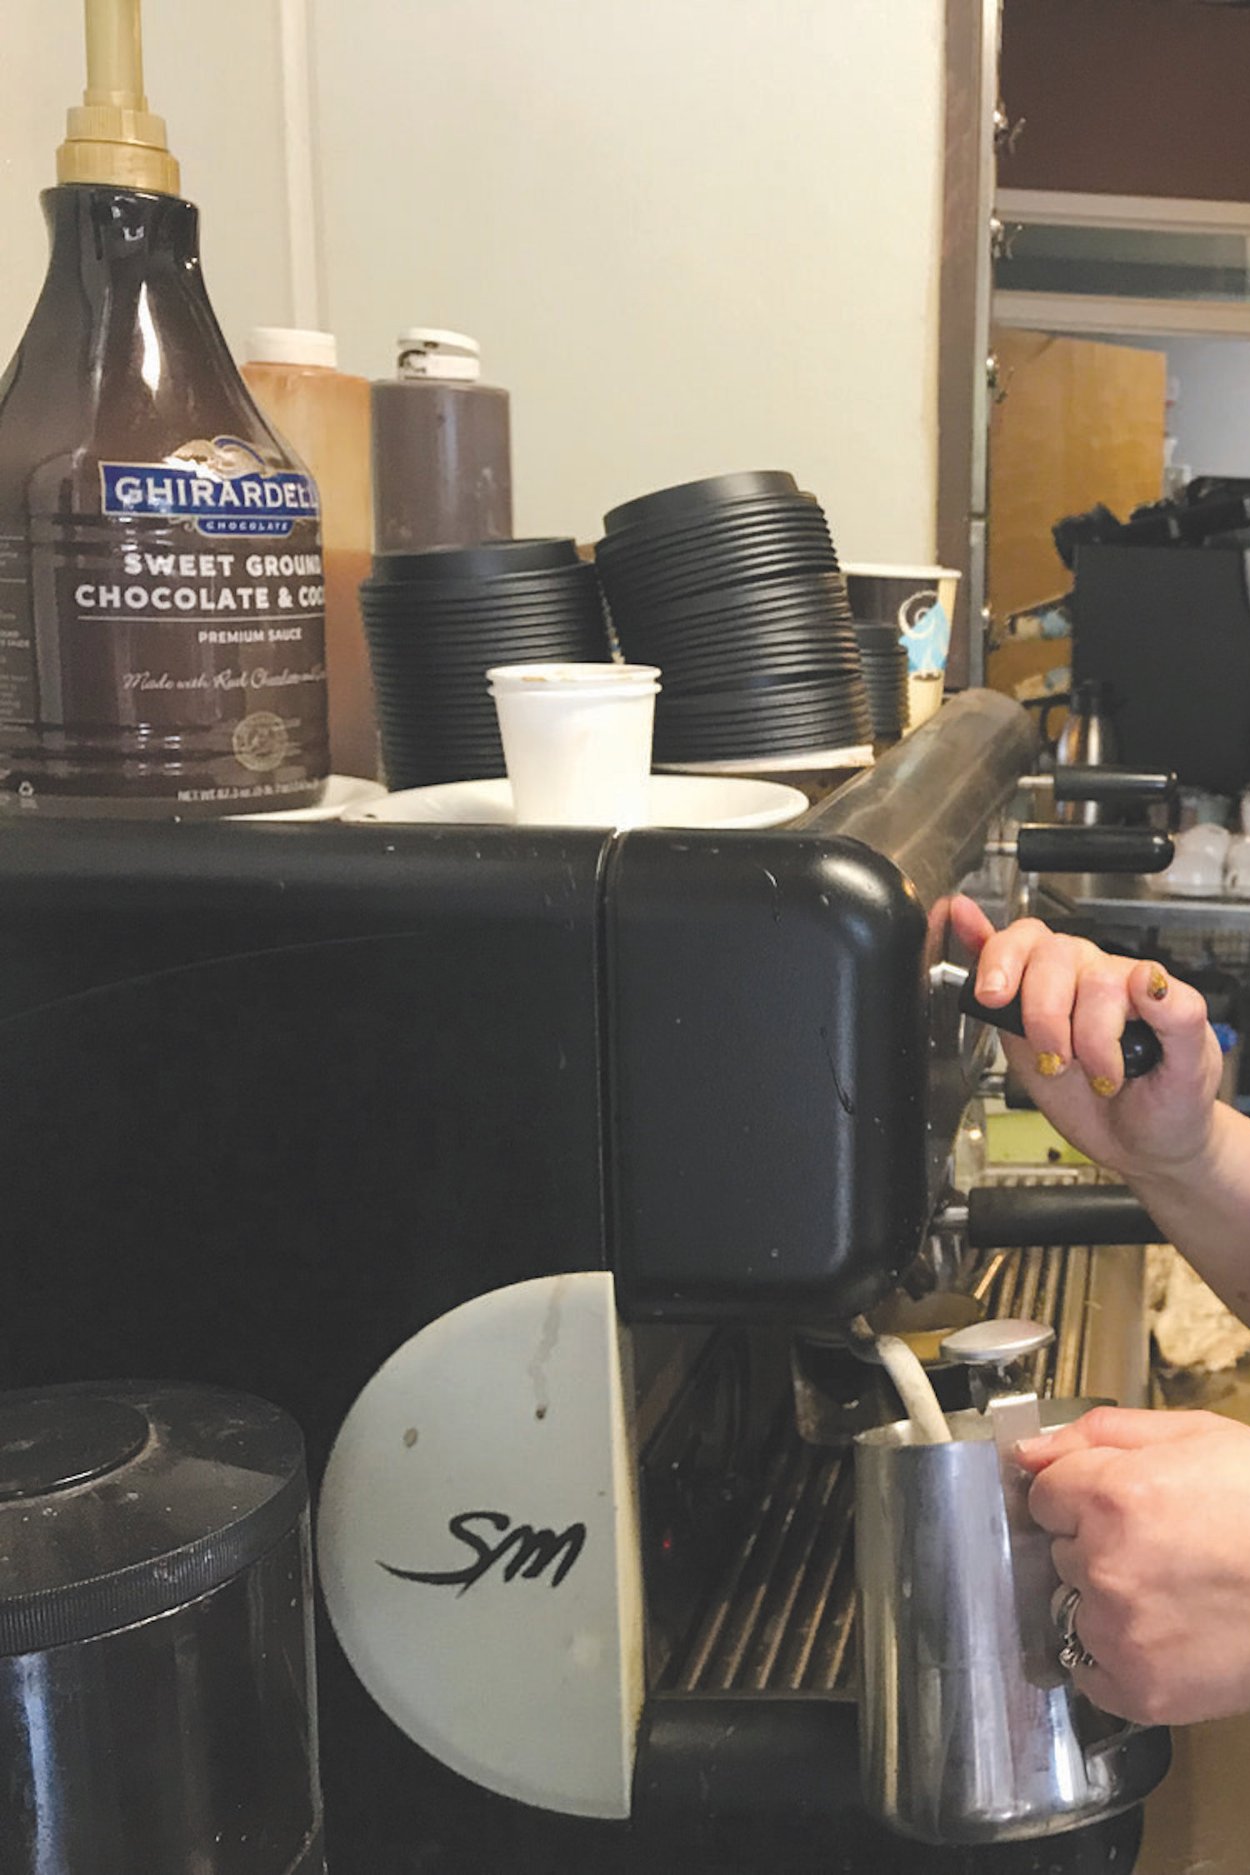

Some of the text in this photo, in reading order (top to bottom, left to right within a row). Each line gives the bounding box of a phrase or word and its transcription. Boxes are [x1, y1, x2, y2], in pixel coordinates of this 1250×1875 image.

[206, 520, 289, 532] CHOCOLATE
[124, 552, 235, 577] SWEET
[74, 584, 270, 610] CHOCOLATE
[277, 586, 294, 608] &
[198, 627, 303, 644] PREMIUM SAUCE
[123, 670, 174, 690] Made
